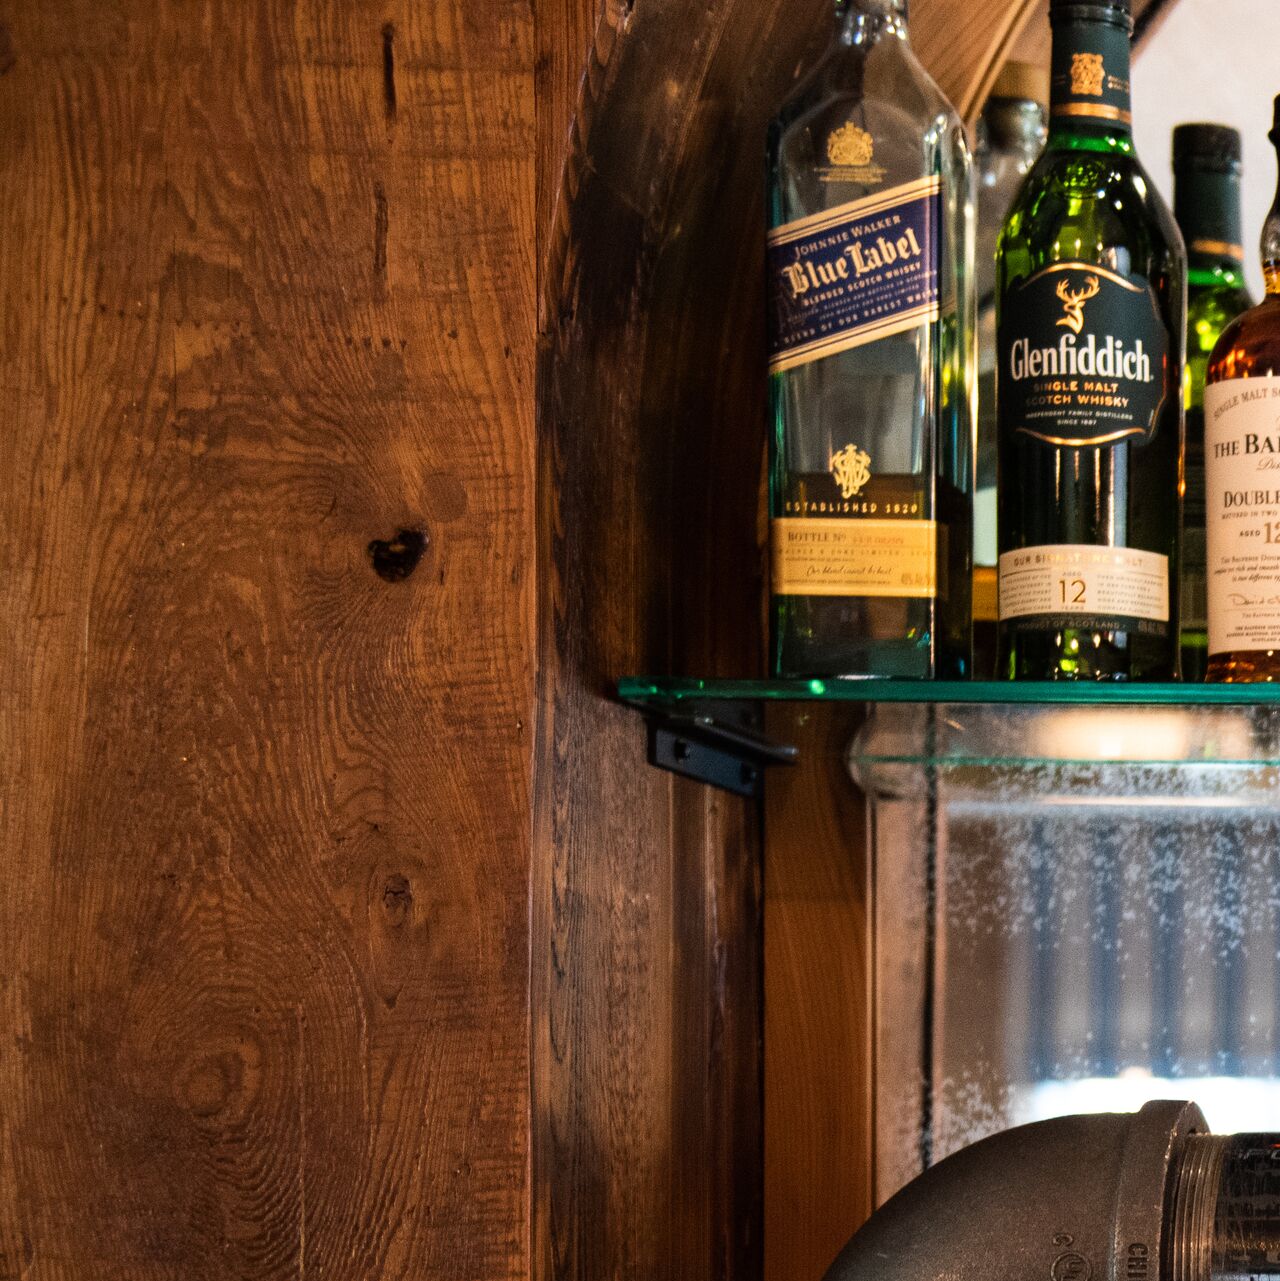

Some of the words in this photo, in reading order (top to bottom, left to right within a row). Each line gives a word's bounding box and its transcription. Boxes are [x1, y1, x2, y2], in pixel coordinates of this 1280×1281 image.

[795, 231, 849, 260] JOHNNIE
[851, 215, 901, 237] WALKER
[782, 255, 849, 298] Blue
[844, 228, 921, 278] Label
[804, 286, 844, 306] BLENDED
[848, 273, 882, 291] SCOTCH
[885, 262, 921, 279] WHISKY
[1011, 333, 1151, 383] Glenfiddich
[1034, 381, 1079, 392] SINGLE
[1084, 382, 1118, 393] MALT
[1026, 395, 1071, 406] SCOTCH
[1077, 395, 1128, 407] WHISKY
[1214, 396, 1242, 421] SINGLE
[1242, 388, 1268, 400] MALT
[1214, 440, 1240, 459] THE
[786, 502, 877, 513] ESTABLISHED
[885, 503, 918, 514] 1820
[788, 532, 829, 543] BOTTLE
[1014, 555, 1030, 566] OUR
[1059, 580, 1086, 603] 12
